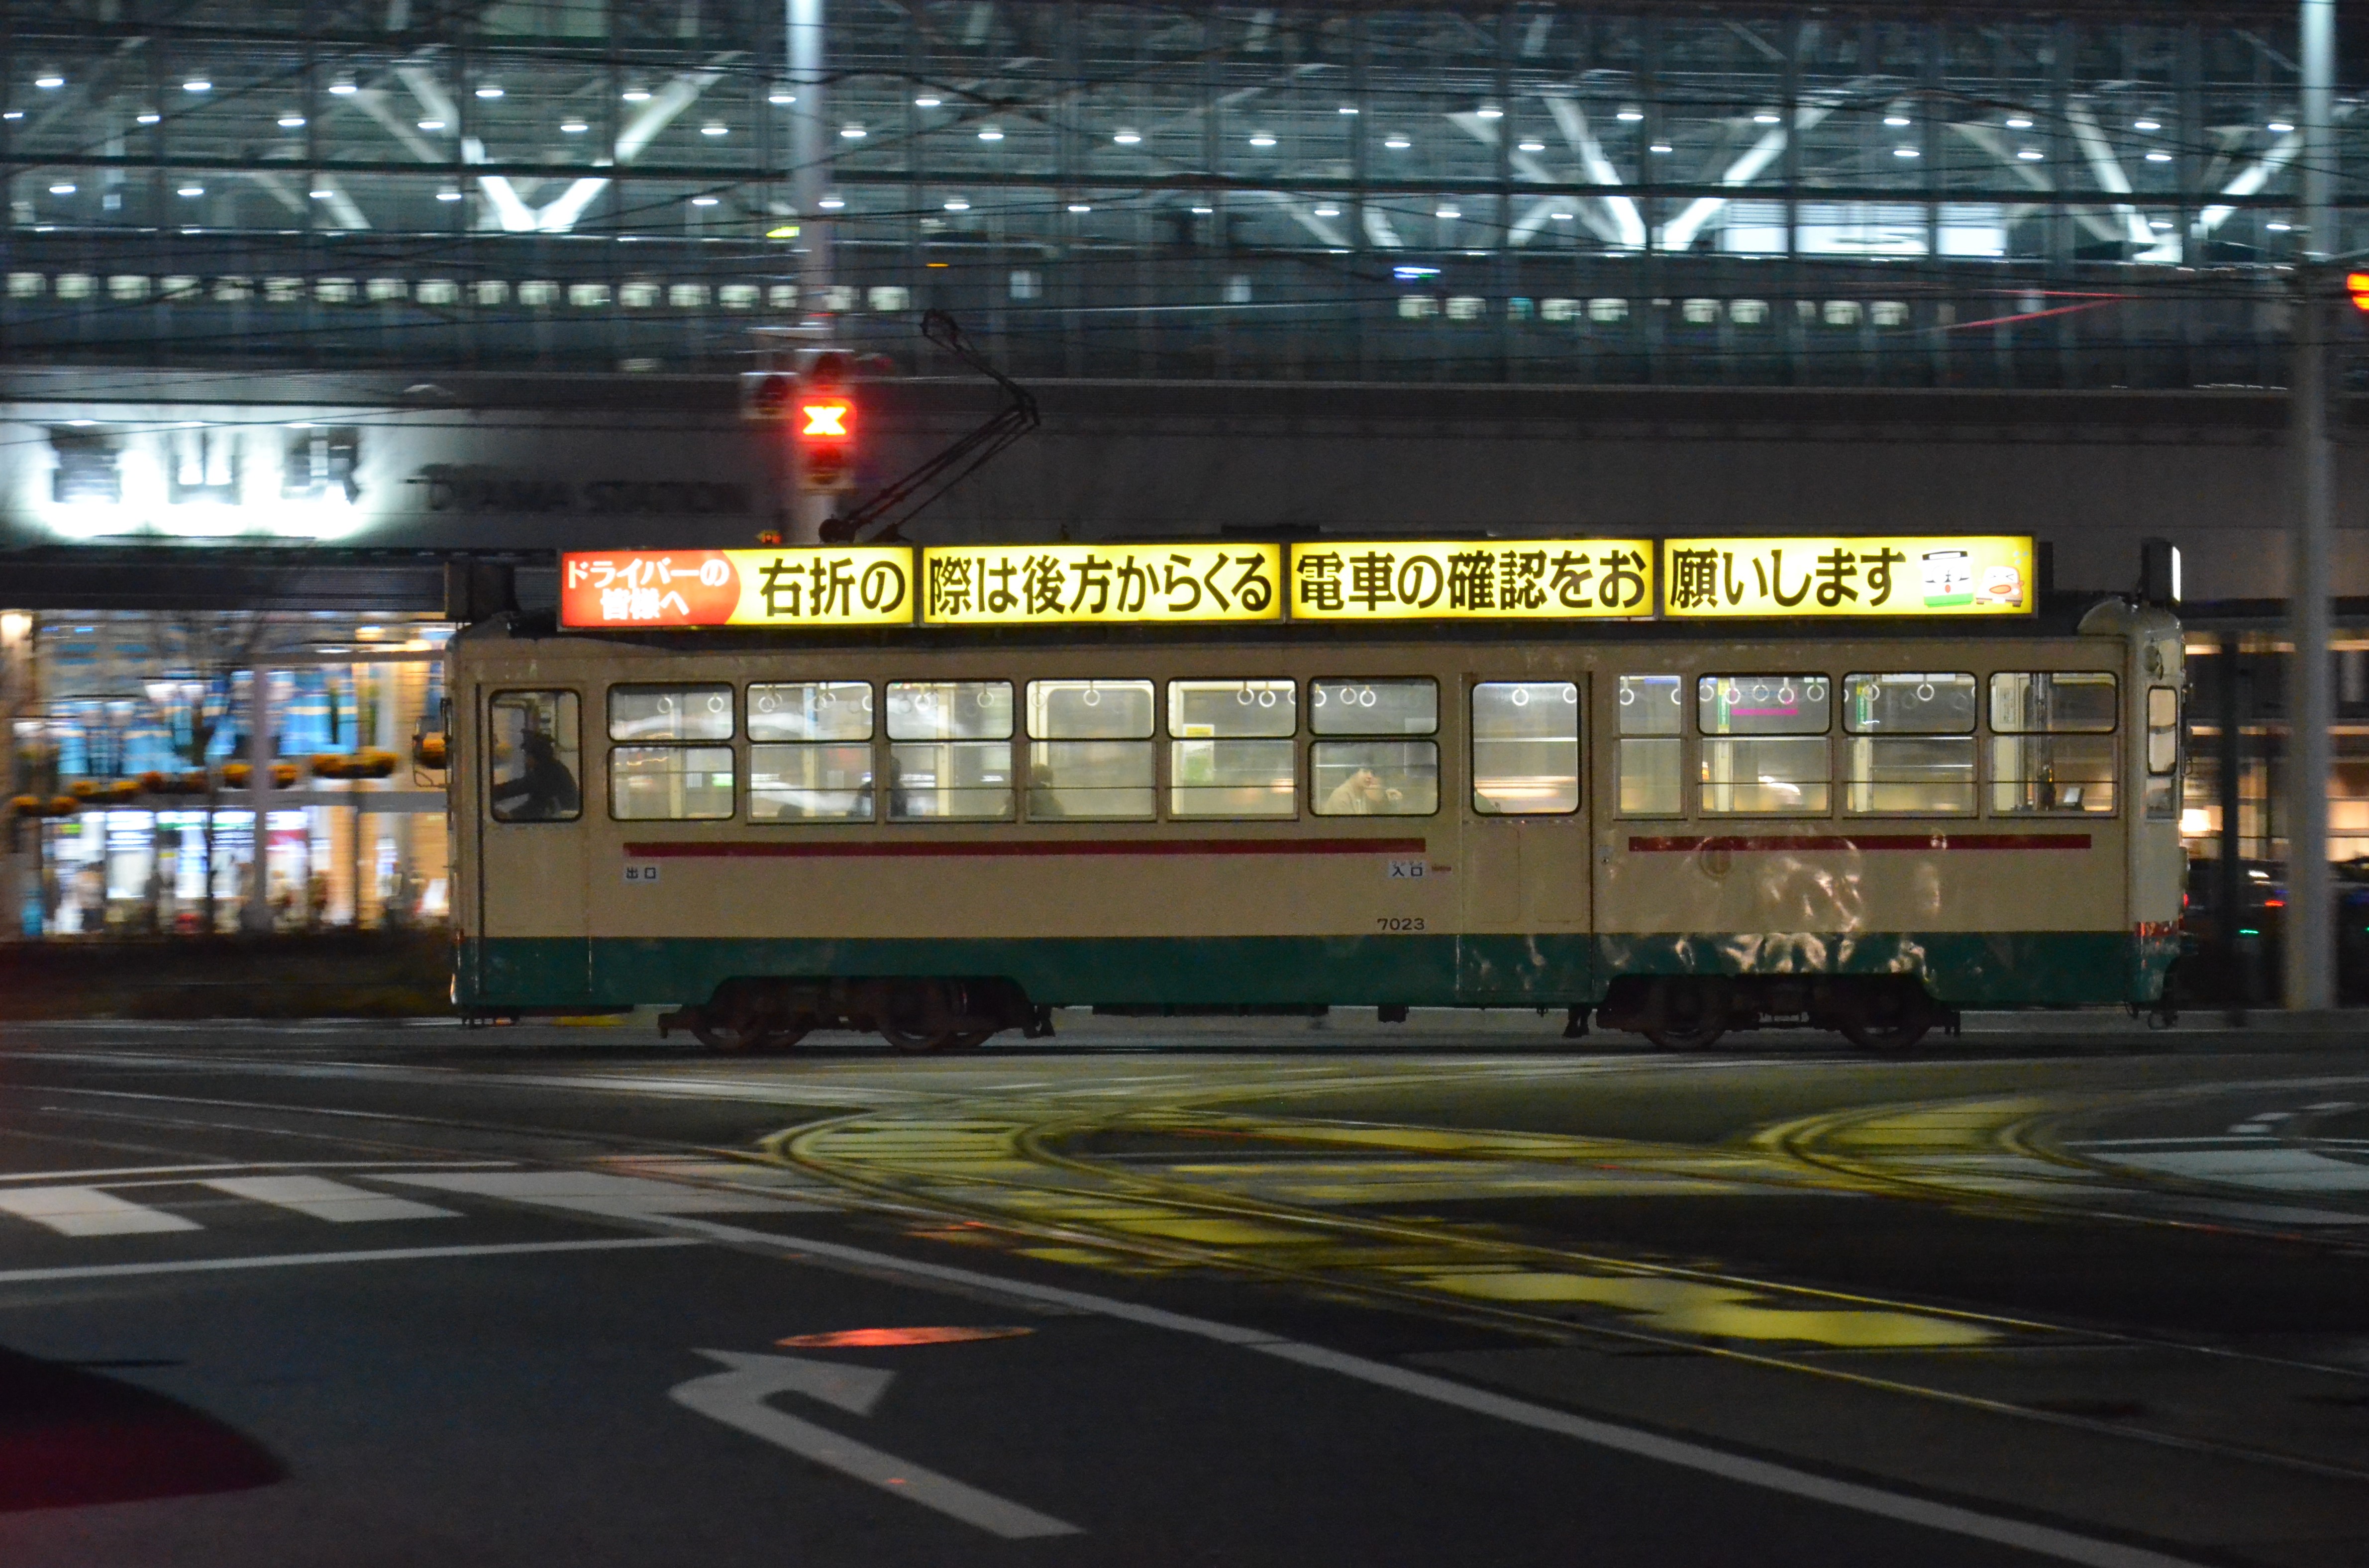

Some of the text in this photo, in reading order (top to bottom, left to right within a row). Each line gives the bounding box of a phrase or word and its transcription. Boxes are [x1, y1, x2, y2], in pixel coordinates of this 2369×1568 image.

[568, 557, 729, 589] ドライバーの
[759, 547, 1906, 617] 右折の 際は後方からくる 電車の確認をお 願いします
[600, 588, 690, 621] 皆様へ
[626, 867, 656, 879] 出口
[1392, 866, 1423, 877] 入口
[1377, 918, 1425, 930] 7023
